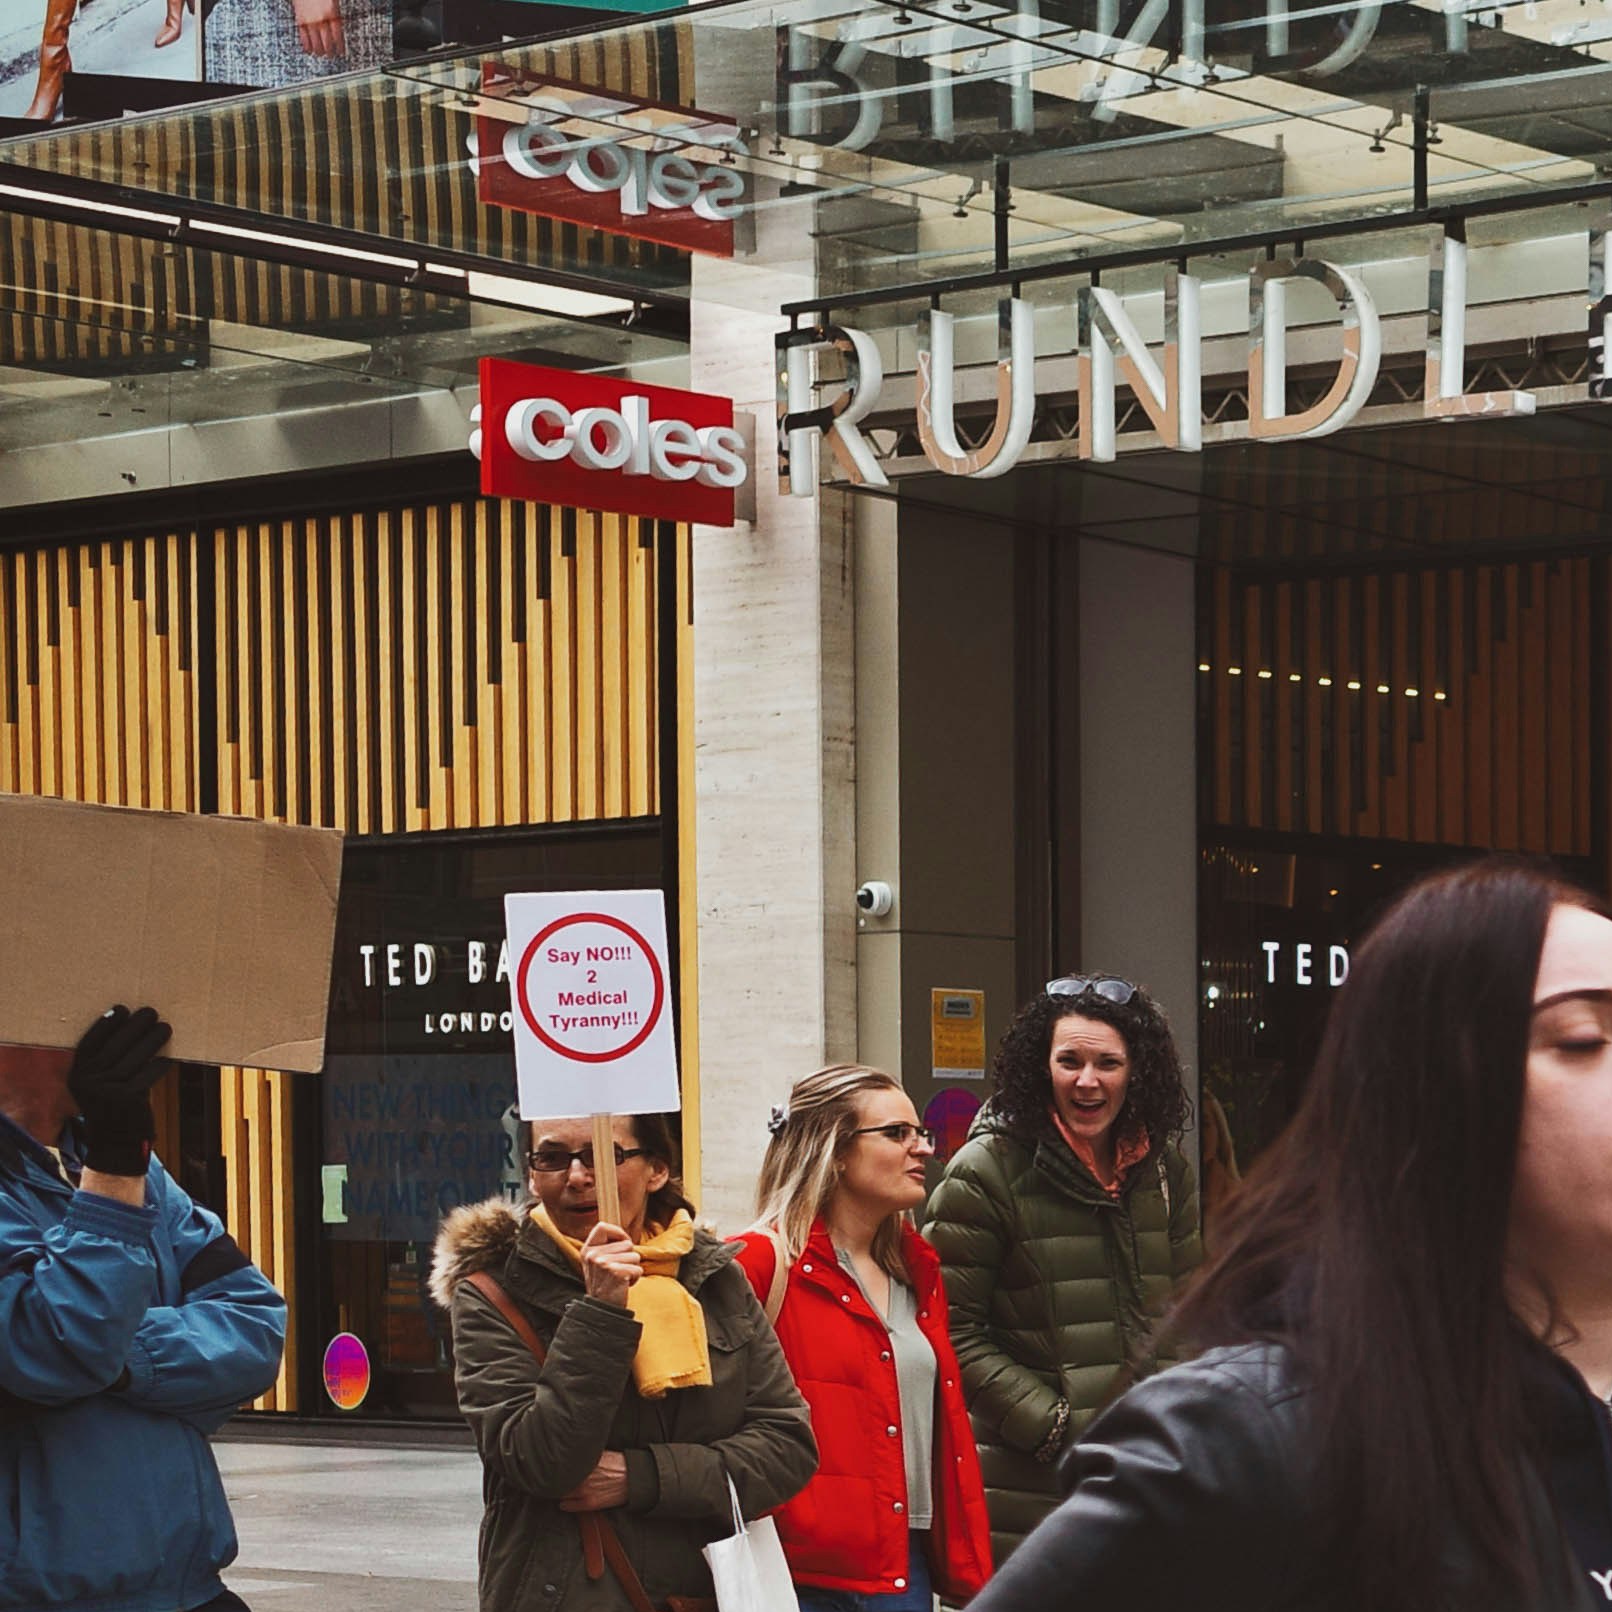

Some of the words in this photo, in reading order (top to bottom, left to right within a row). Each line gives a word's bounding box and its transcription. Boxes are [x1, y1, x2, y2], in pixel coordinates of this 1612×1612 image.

[504, 396, 748, 488] coles
[360, 943, 435, 987] TED
[547, 948, 580, 966] Say
[586, 946, 632, 962] NO!!!
[1262, 942, 1350, 987] TED
[587, 970, 597, 983] 2
[558, 991, 628, 1007] Medical
[550, 1012, 639, 1032] Tyranny!!!
